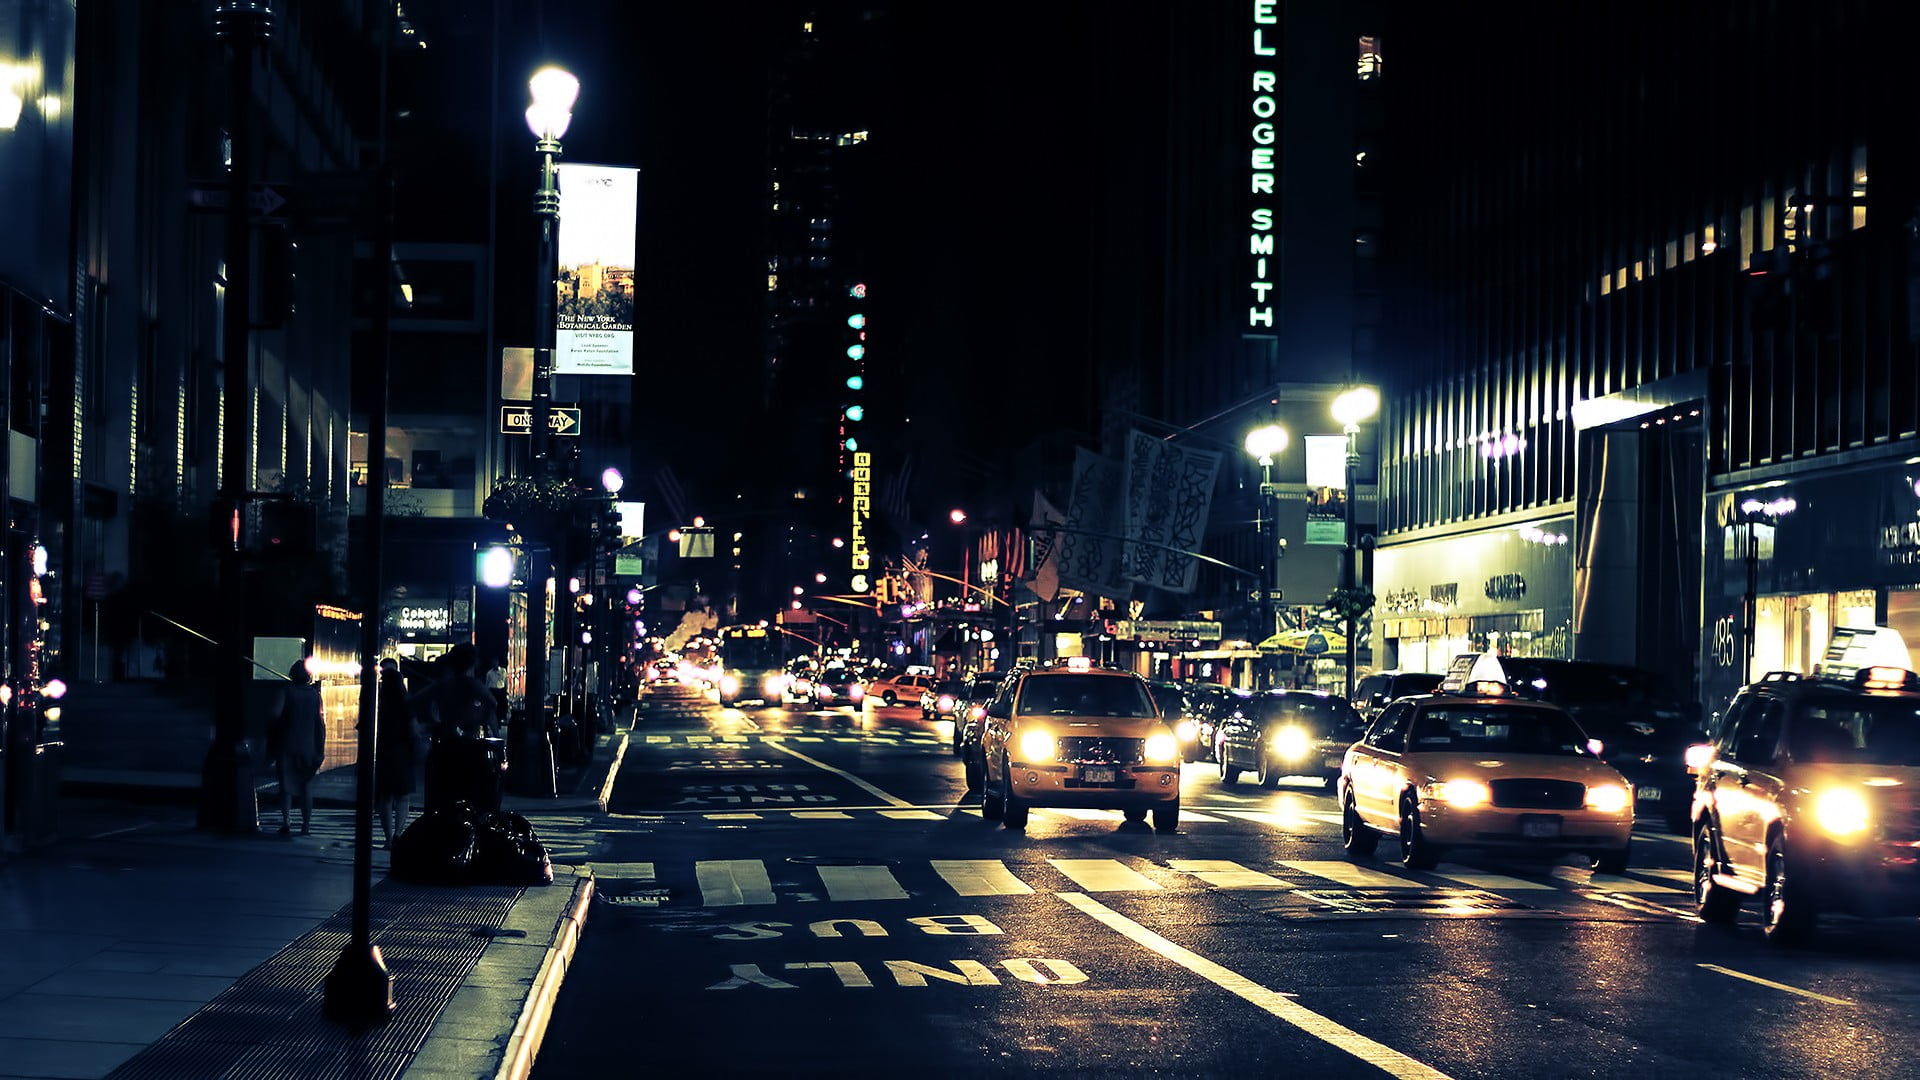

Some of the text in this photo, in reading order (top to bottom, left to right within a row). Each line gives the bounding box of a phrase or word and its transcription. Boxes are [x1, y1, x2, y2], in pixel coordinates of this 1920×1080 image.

[1251, 70, 1276, 194] ROGER
[1250, 208, 1274, 328] SMITH
[559, 314, 575, 322] THE
[596, 315, 616, 323] YORK
[559, 322, 633, 330] BOTANICAL GARDEN
[401, 607, 449, 619] Cohen's
[1711, 617, 1735, 667] 485
[711, 914, 1005, 940] BUS
[705, 957, 1090, 991] ONLY
